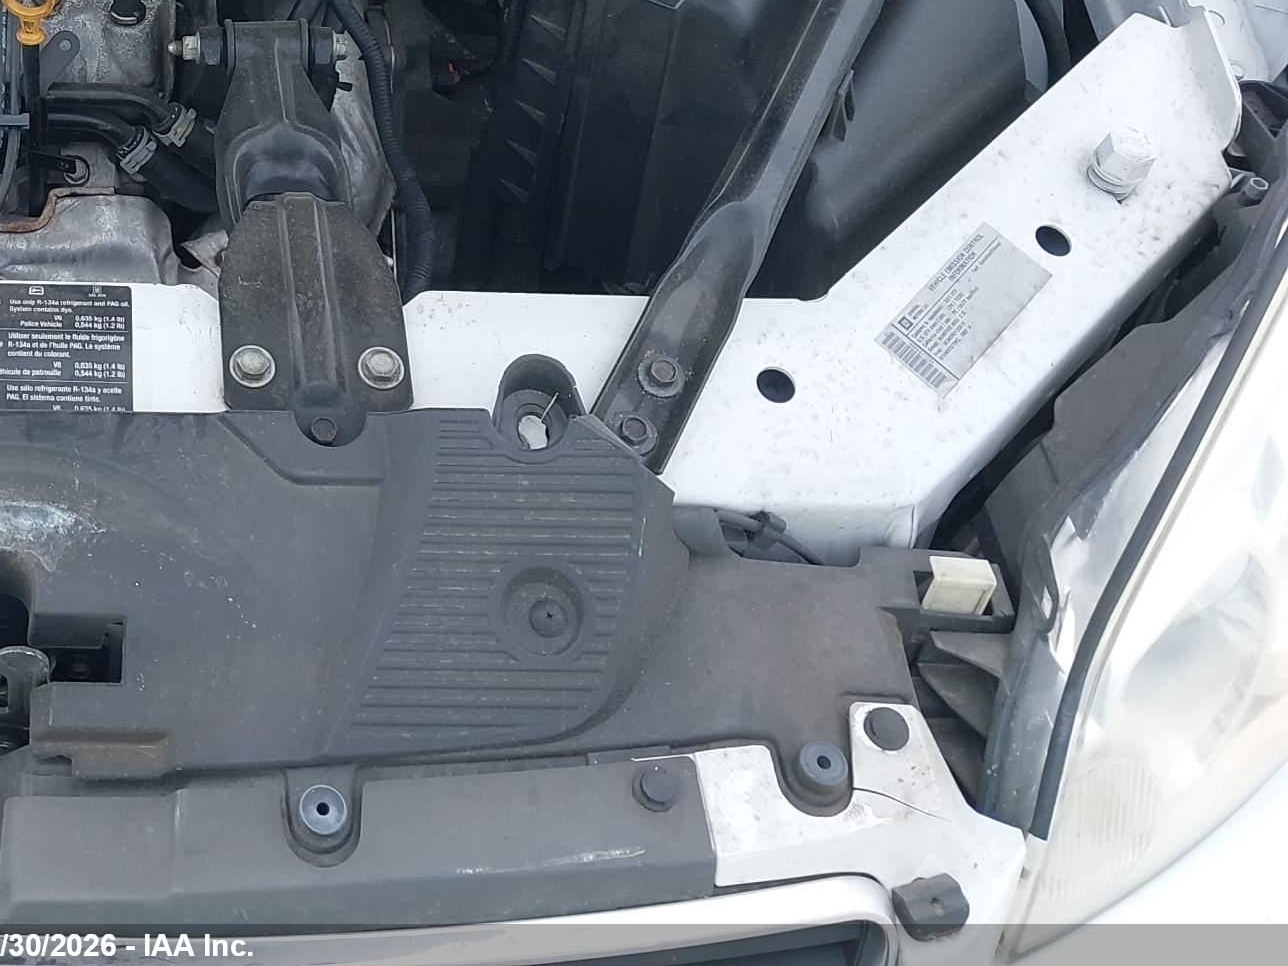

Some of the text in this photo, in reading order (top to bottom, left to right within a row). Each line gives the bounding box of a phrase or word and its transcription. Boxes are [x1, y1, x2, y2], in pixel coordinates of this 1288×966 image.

[91, 334, 125, 342] frigorigène
[117, 363, 125, 371] lb)
[35, 385, 71, 393] refrigerante
